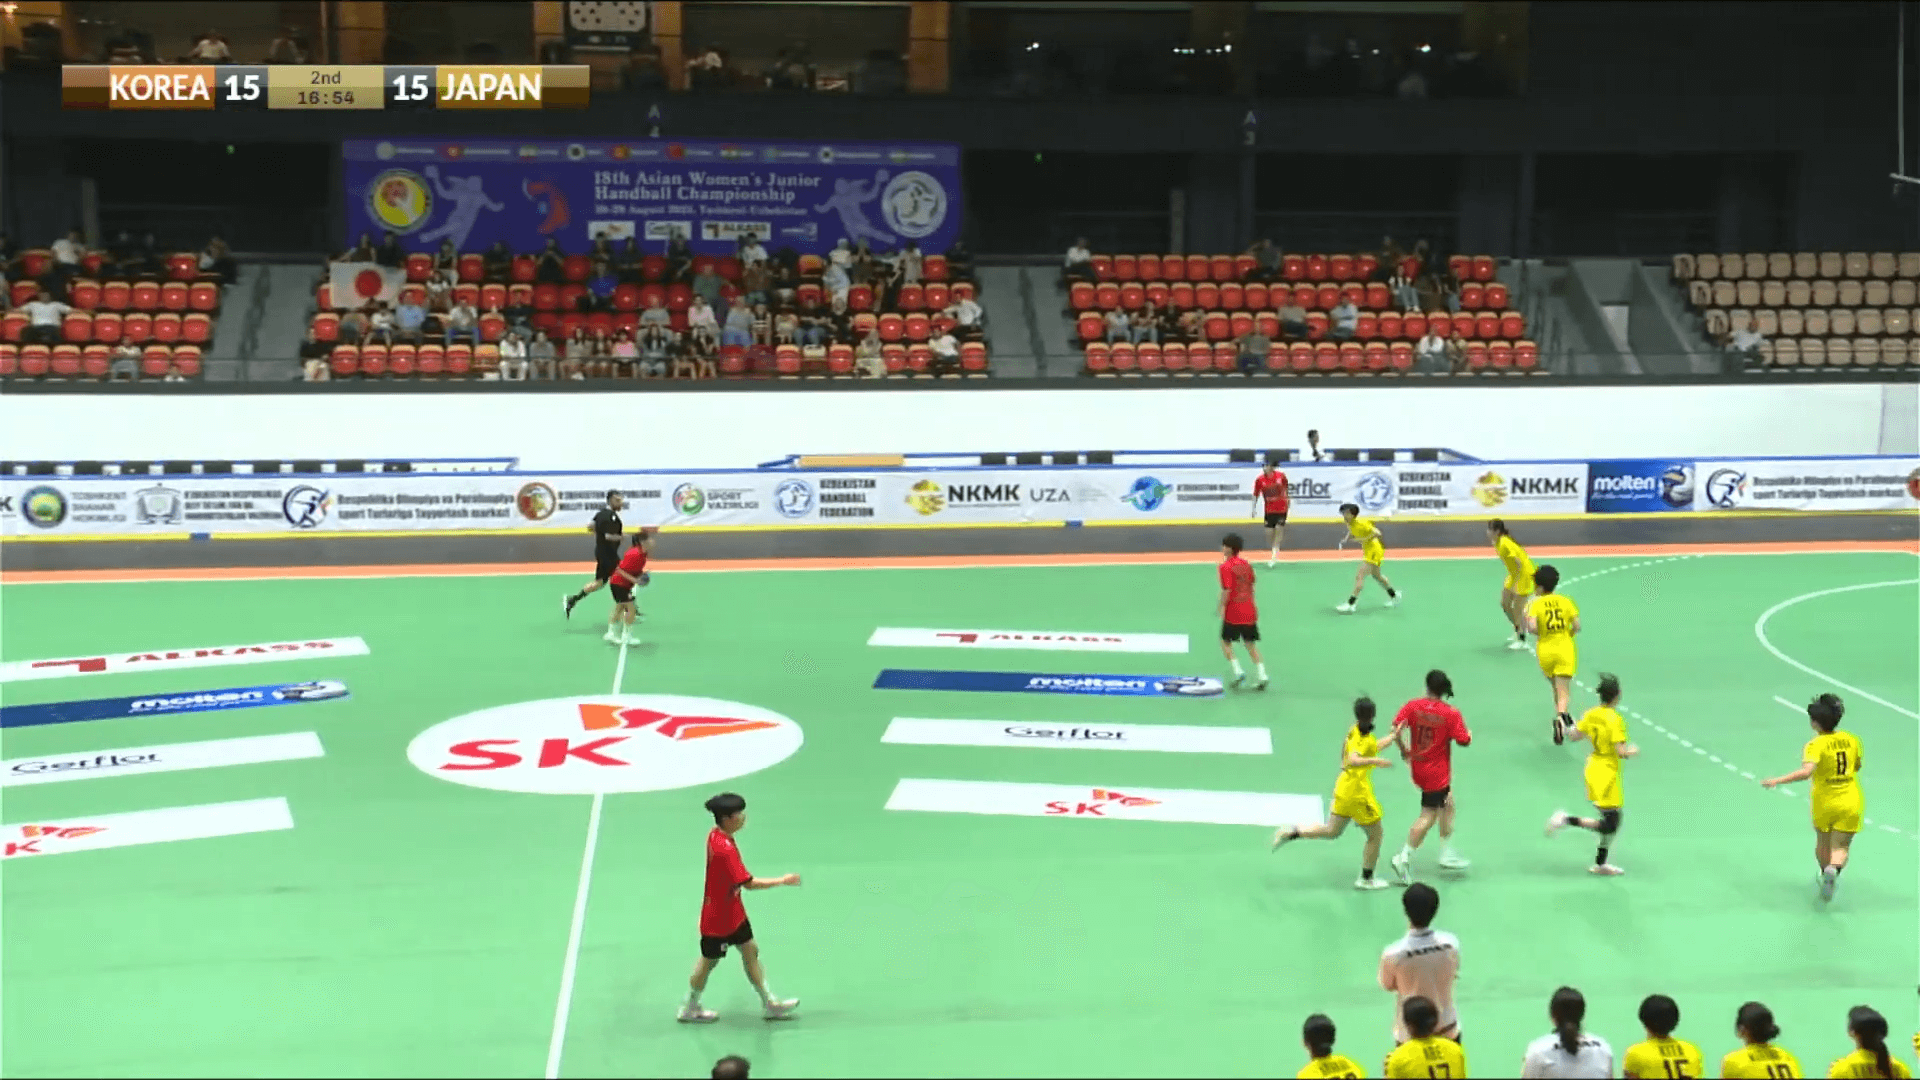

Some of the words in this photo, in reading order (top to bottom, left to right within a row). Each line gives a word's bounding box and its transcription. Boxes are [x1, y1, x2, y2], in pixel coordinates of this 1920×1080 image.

[594, 171, 630, 185] 18th
[637, 171, 682, 186] Asian
[689, 171, 762, 186] Women's
[767, 172, 821, 187] Junior
[594, 186, 671, 200] Handball
[677, 186, 796, 205] Championship
[820, 478, 876, 489] UZBEKISTAN
[1399, 472, 1451, 482] UZBEKISTAN
[1594, 475, 1657, 491] molten
[948, 484, 1021, 502] NKMK
[1287, 478, 1331, 498] erflor
[1511, 477, 1579, 495] NKMK
[820, 493, 866, 503] HANDBALL
[1029, 488, 1070, 502] UZA
[820, 507, 874, 517] FEDERATION
[1545, 608, 1565, 631] 25
[988, 633, 1123, 643] ALKASS
[125, 640, 335, 664] ALKASS
[1028, 676, 1147, 689] molten
[130, 690, 265, 710] molten
[1004, 725, 1129, 741] Gerflor
[436, 735, 633, 770] SK
[11, 752, 160, 775] Gerflor
[1044, 799, 1106, 816] SK
